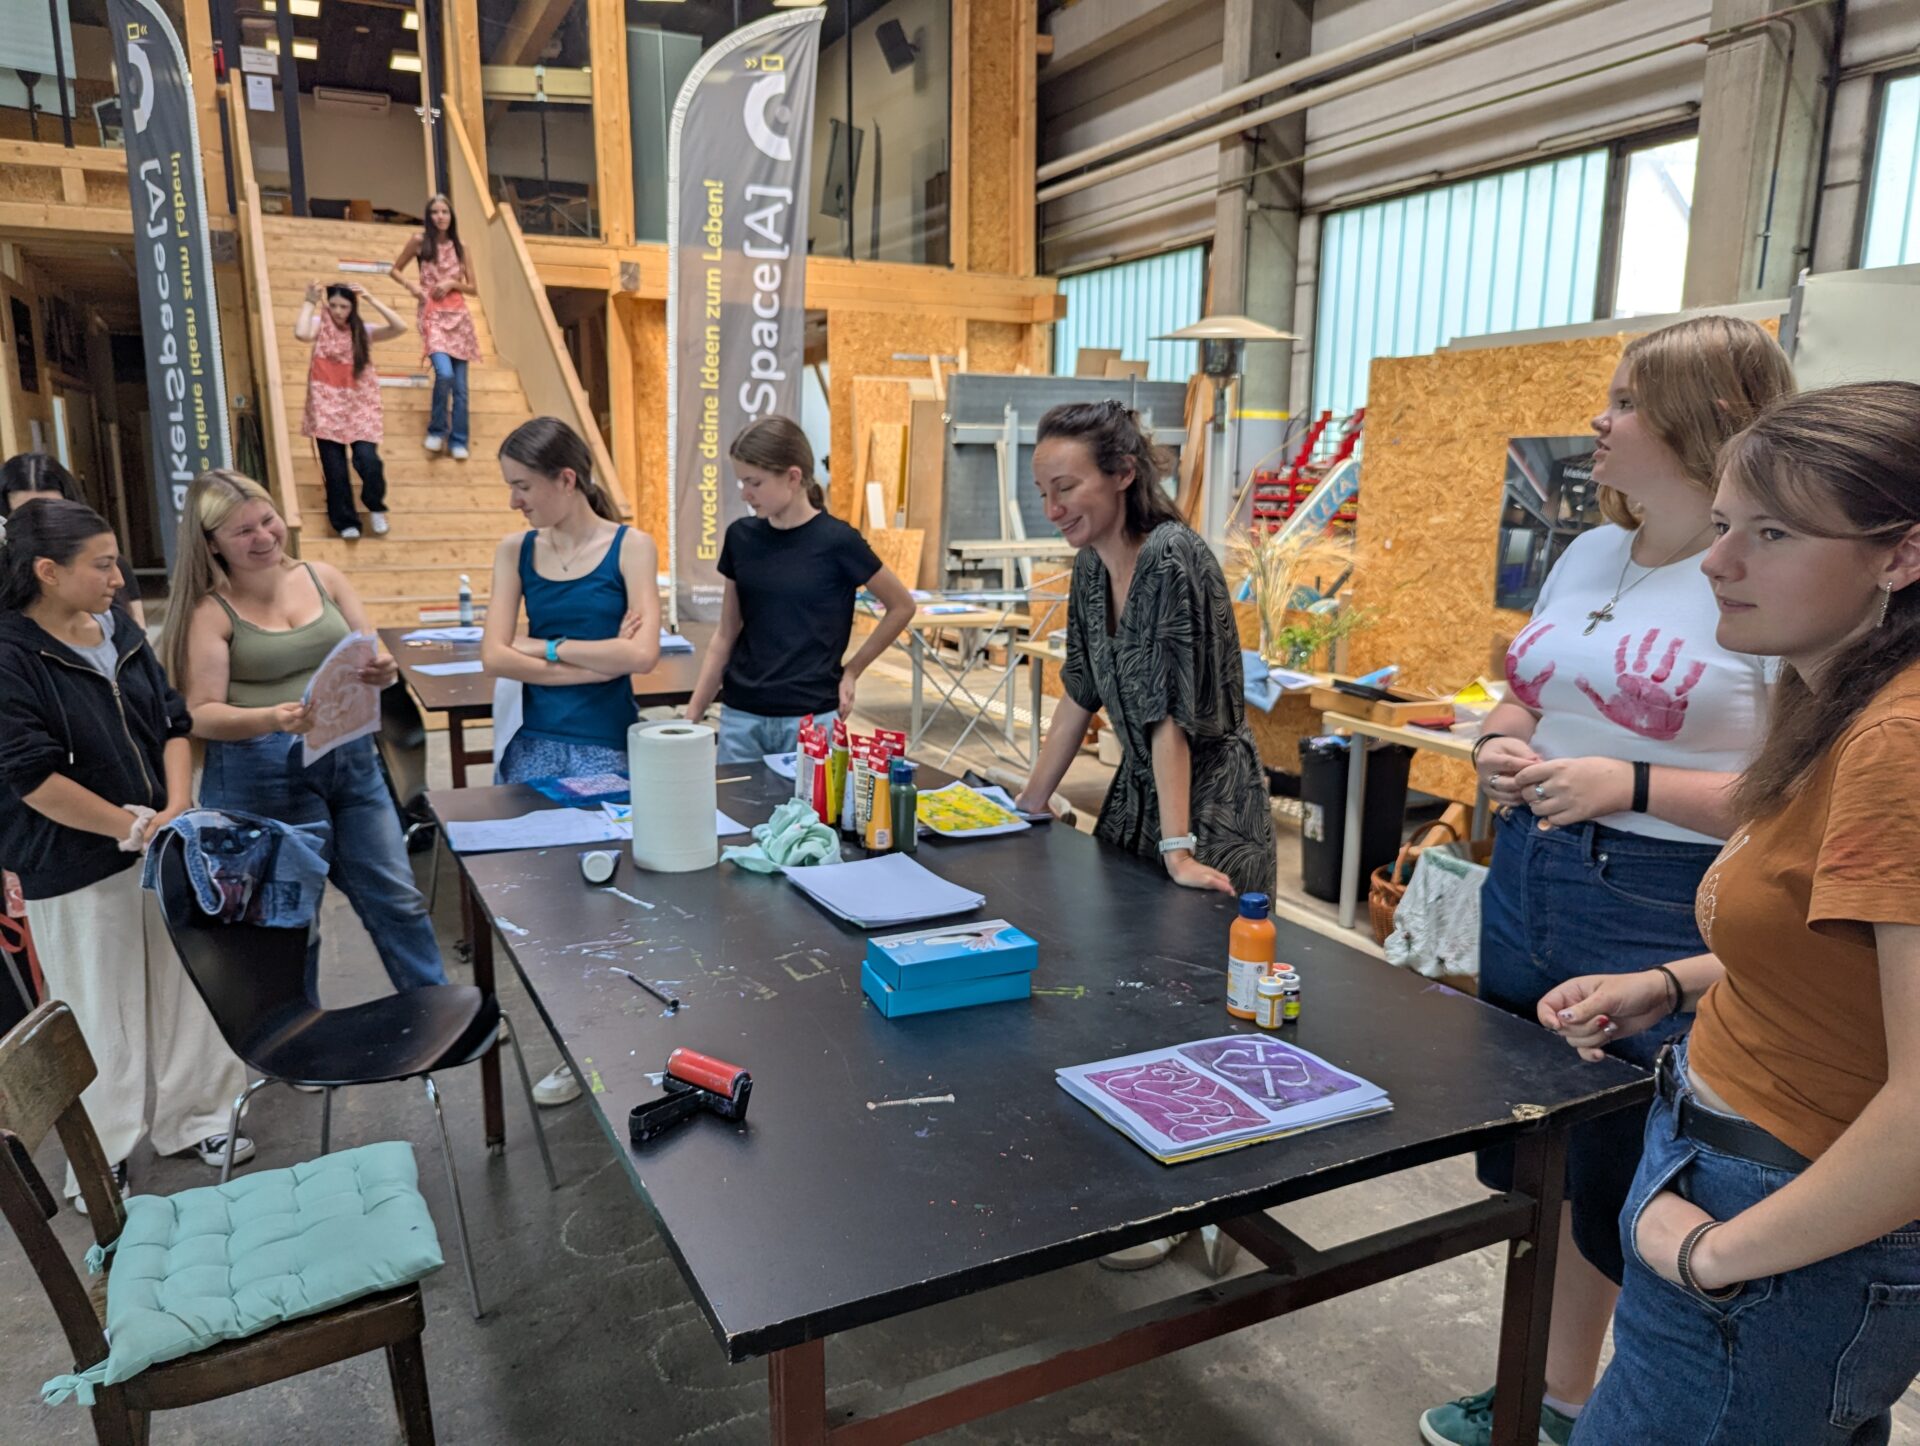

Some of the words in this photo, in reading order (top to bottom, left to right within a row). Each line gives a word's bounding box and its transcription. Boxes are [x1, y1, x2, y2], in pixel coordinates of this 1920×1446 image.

[702, 179, 725, 262] Leben!
[705, 268, 722, 320] zum
[739, 184, 794, 421] Space[A]
[700, 325, 721, 391] Ideen
[698, 395, 720, 459] deine
[697, 463, 719, 561] Erwecke
